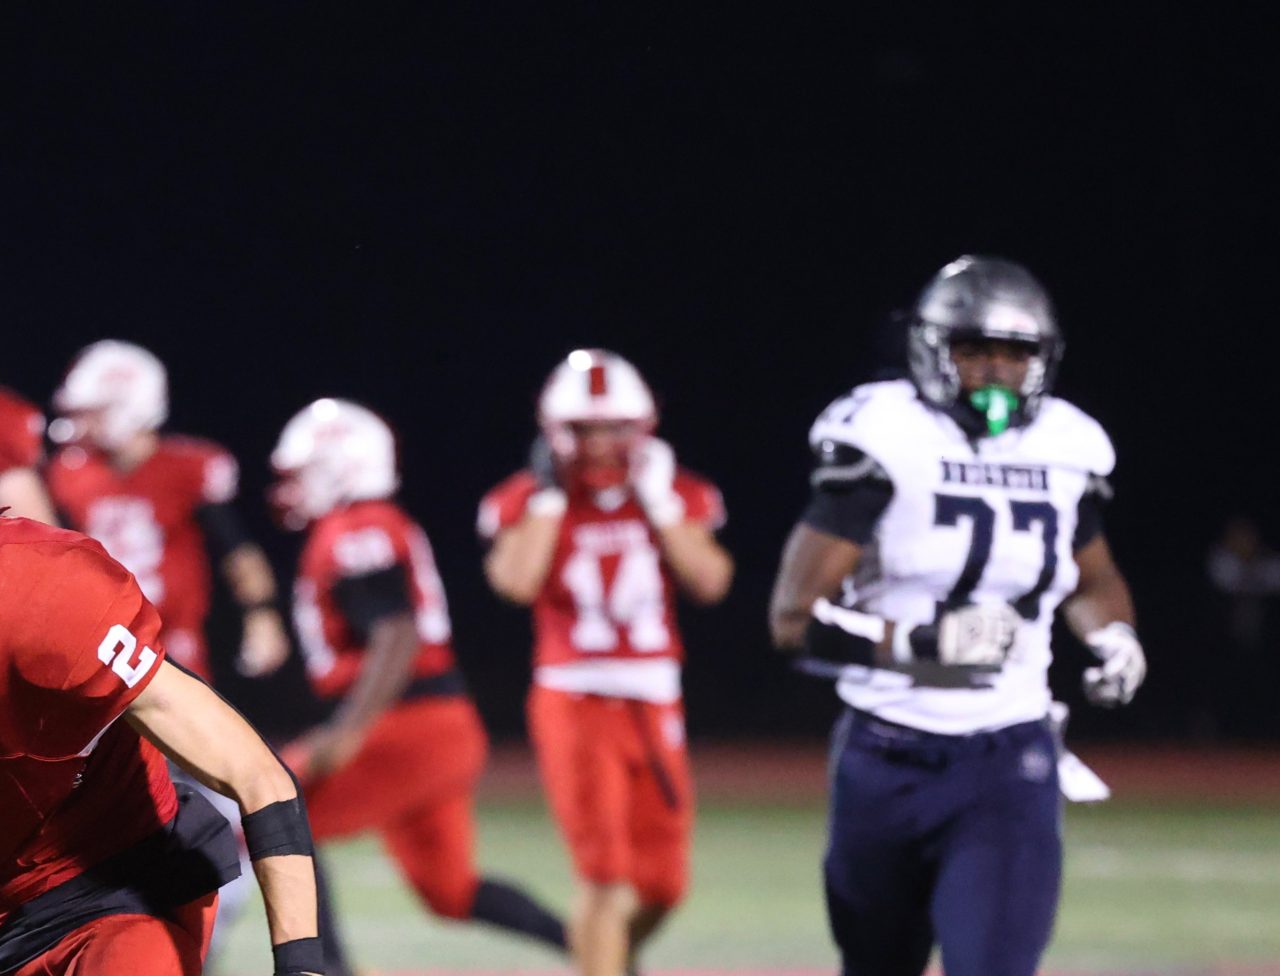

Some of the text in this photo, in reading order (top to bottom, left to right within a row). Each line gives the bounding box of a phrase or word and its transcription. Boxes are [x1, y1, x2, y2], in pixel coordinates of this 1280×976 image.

[562, 548, 670, 651] 14
[933, 493, 1058, 621] 77
[97, 624, 158, 689] 2
